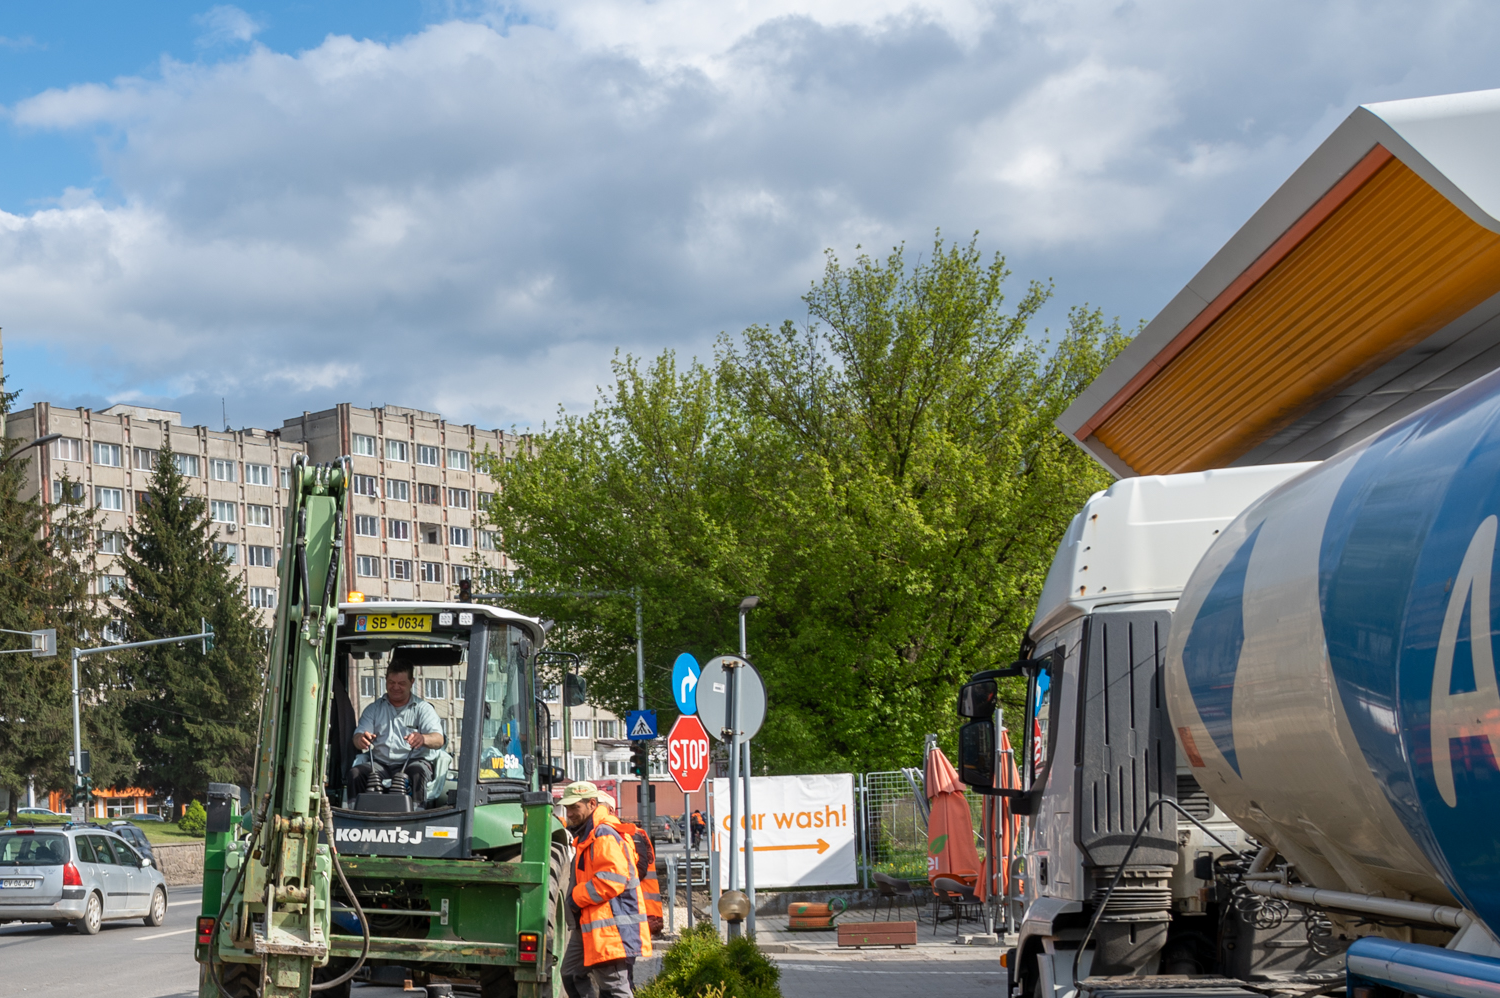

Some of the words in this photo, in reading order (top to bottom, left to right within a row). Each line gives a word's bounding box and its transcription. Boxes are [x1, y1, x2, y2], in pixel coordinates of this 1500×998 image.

[371, 617, 388, 629] SB
[397, 617, 425, 629] 0634
[670, 739, 708, 770] STOP
[773, 804, 847, 830] wash!
